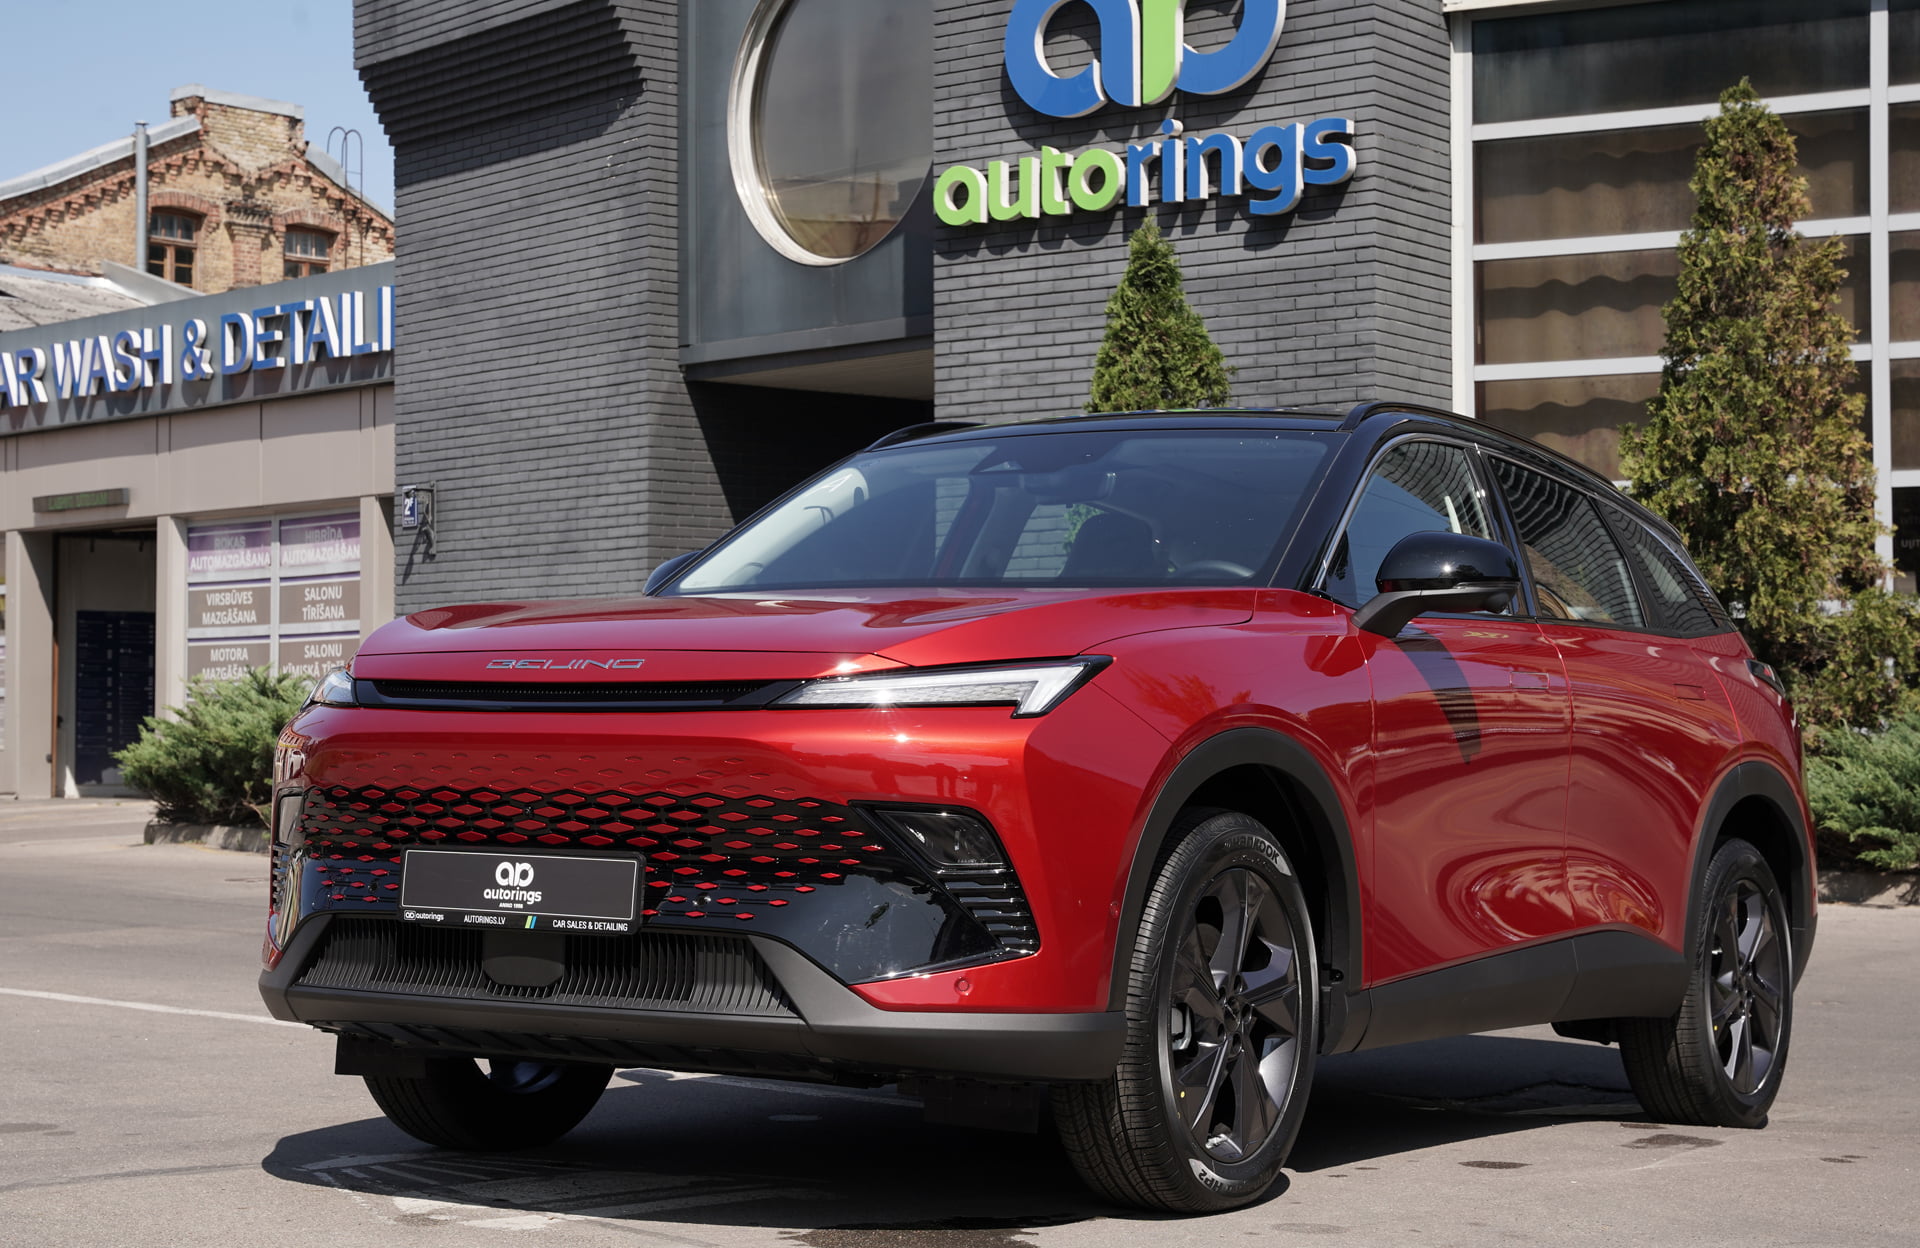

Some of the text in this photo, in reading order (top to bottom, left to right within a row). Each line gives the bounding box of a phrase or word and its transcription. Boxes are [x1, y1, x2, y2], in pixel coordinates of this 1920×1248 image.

[933, 118, 1357, 226] autorings
[51, 324, 172, 399] WASH
[181, 318, 214, 381] &
[220, 285, 395, 375] DETAILI
[214, 535, 246, 551] ROKAS
[304, 526, 343, 546] HIBRĪDA
[190, 550, 271, 571] AUTOMAZGĀŠANA
[206, 589, 253, 606] VIRSBŪVES
[304, 586, 342, 601] SALONU
[202, 608, 256, 625] MAZGĀŠANA
[302, 604, 344, 621] TĪRĪŠANA
[210, 648, 248, 662] MOTORA
[304, 643, 342, 659] SALONU
[483, 886, 542, 905] autorings
[415, 912, 444, 922] autorings
[463, 914, 506, 925] AUTORINGS.LV
[552, 919, 566, 928] CAR
[566, 920, 588, 930] SALES
[588, 921, 593, 930] &
[594, 921, 628, 932] DETAILING
